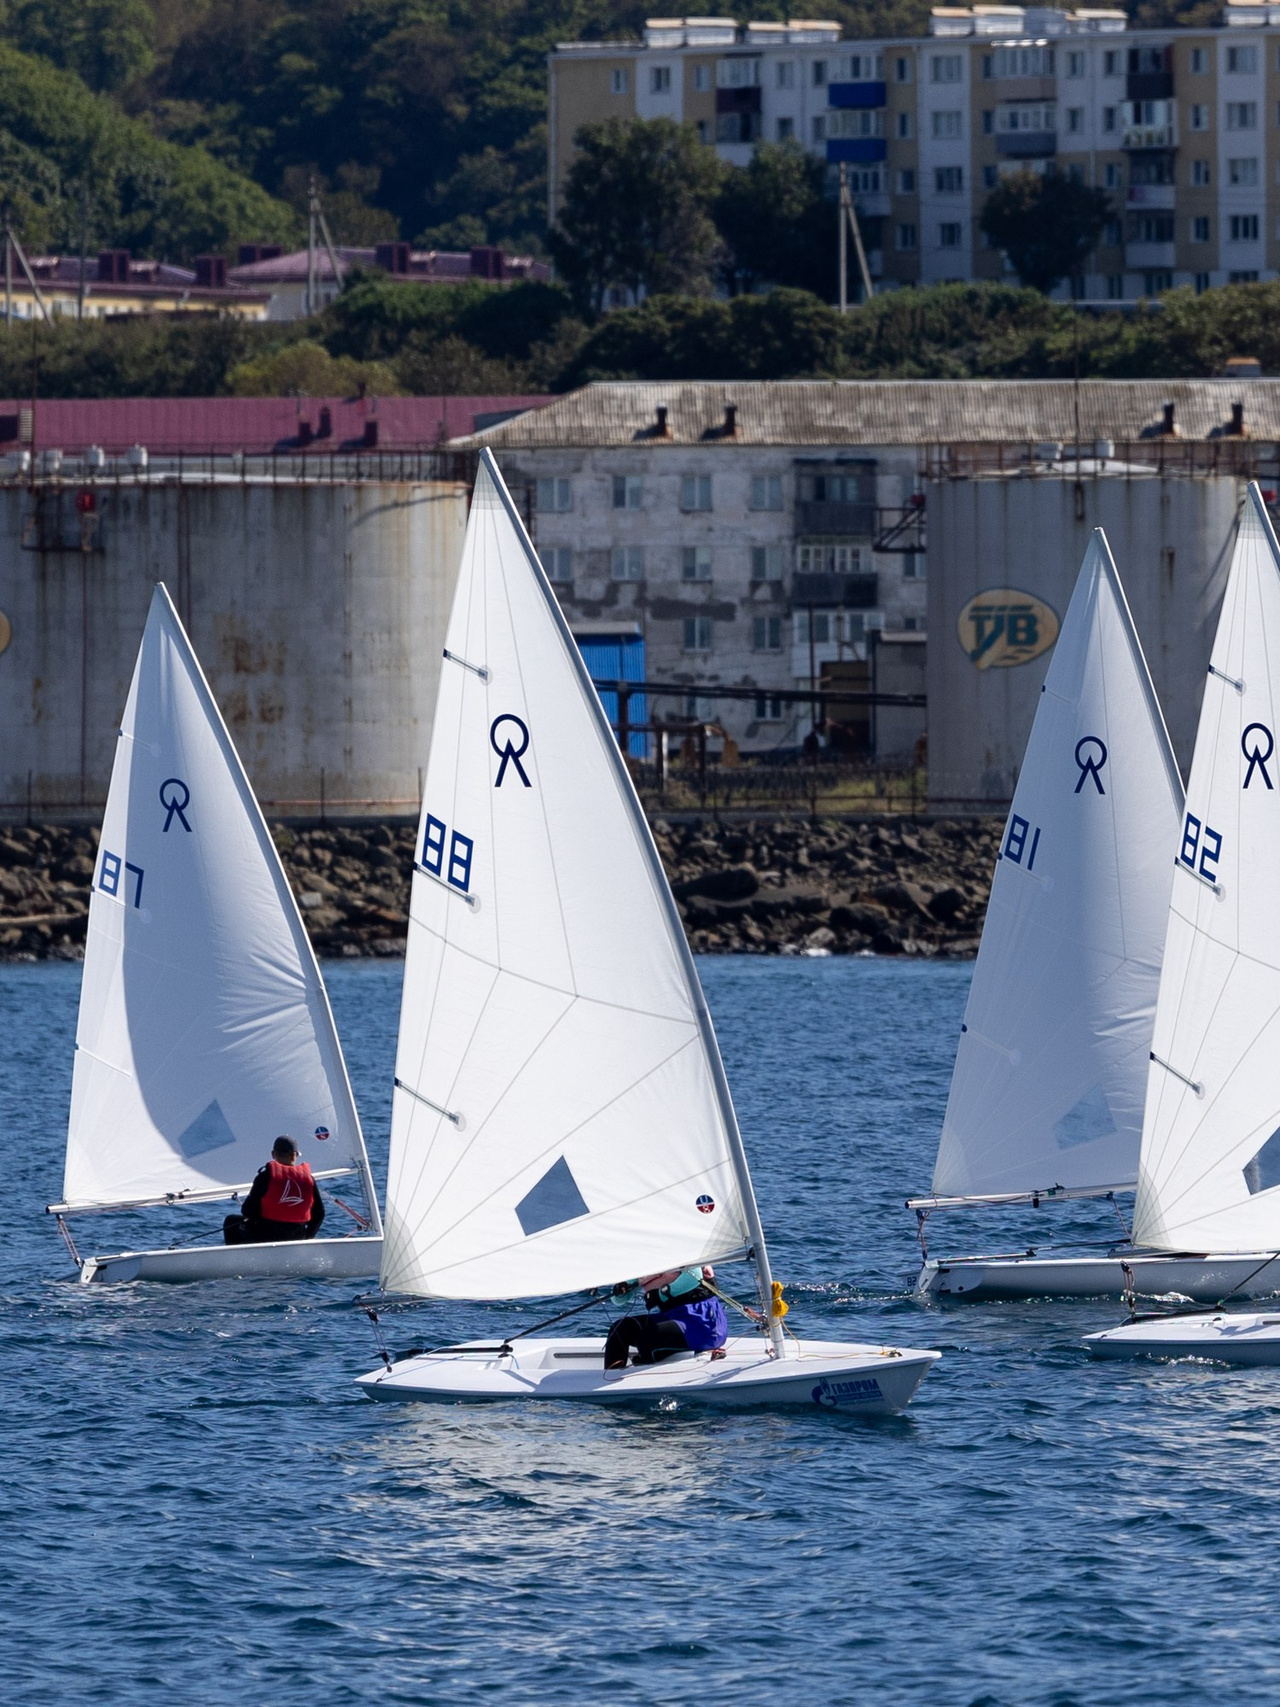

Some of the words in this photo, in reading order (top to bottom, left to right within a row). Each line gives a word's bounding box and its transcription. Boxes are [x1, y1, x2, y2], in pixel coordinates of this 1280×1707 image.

[421, 813, 474, 892] 88
[1003, 813, 1042, 872] 81
[1179, 812, 1223, 884] 82
[99, 850, 145, 909] 87
[831, 1378, 880, 1395] ГАЗПРОМ
